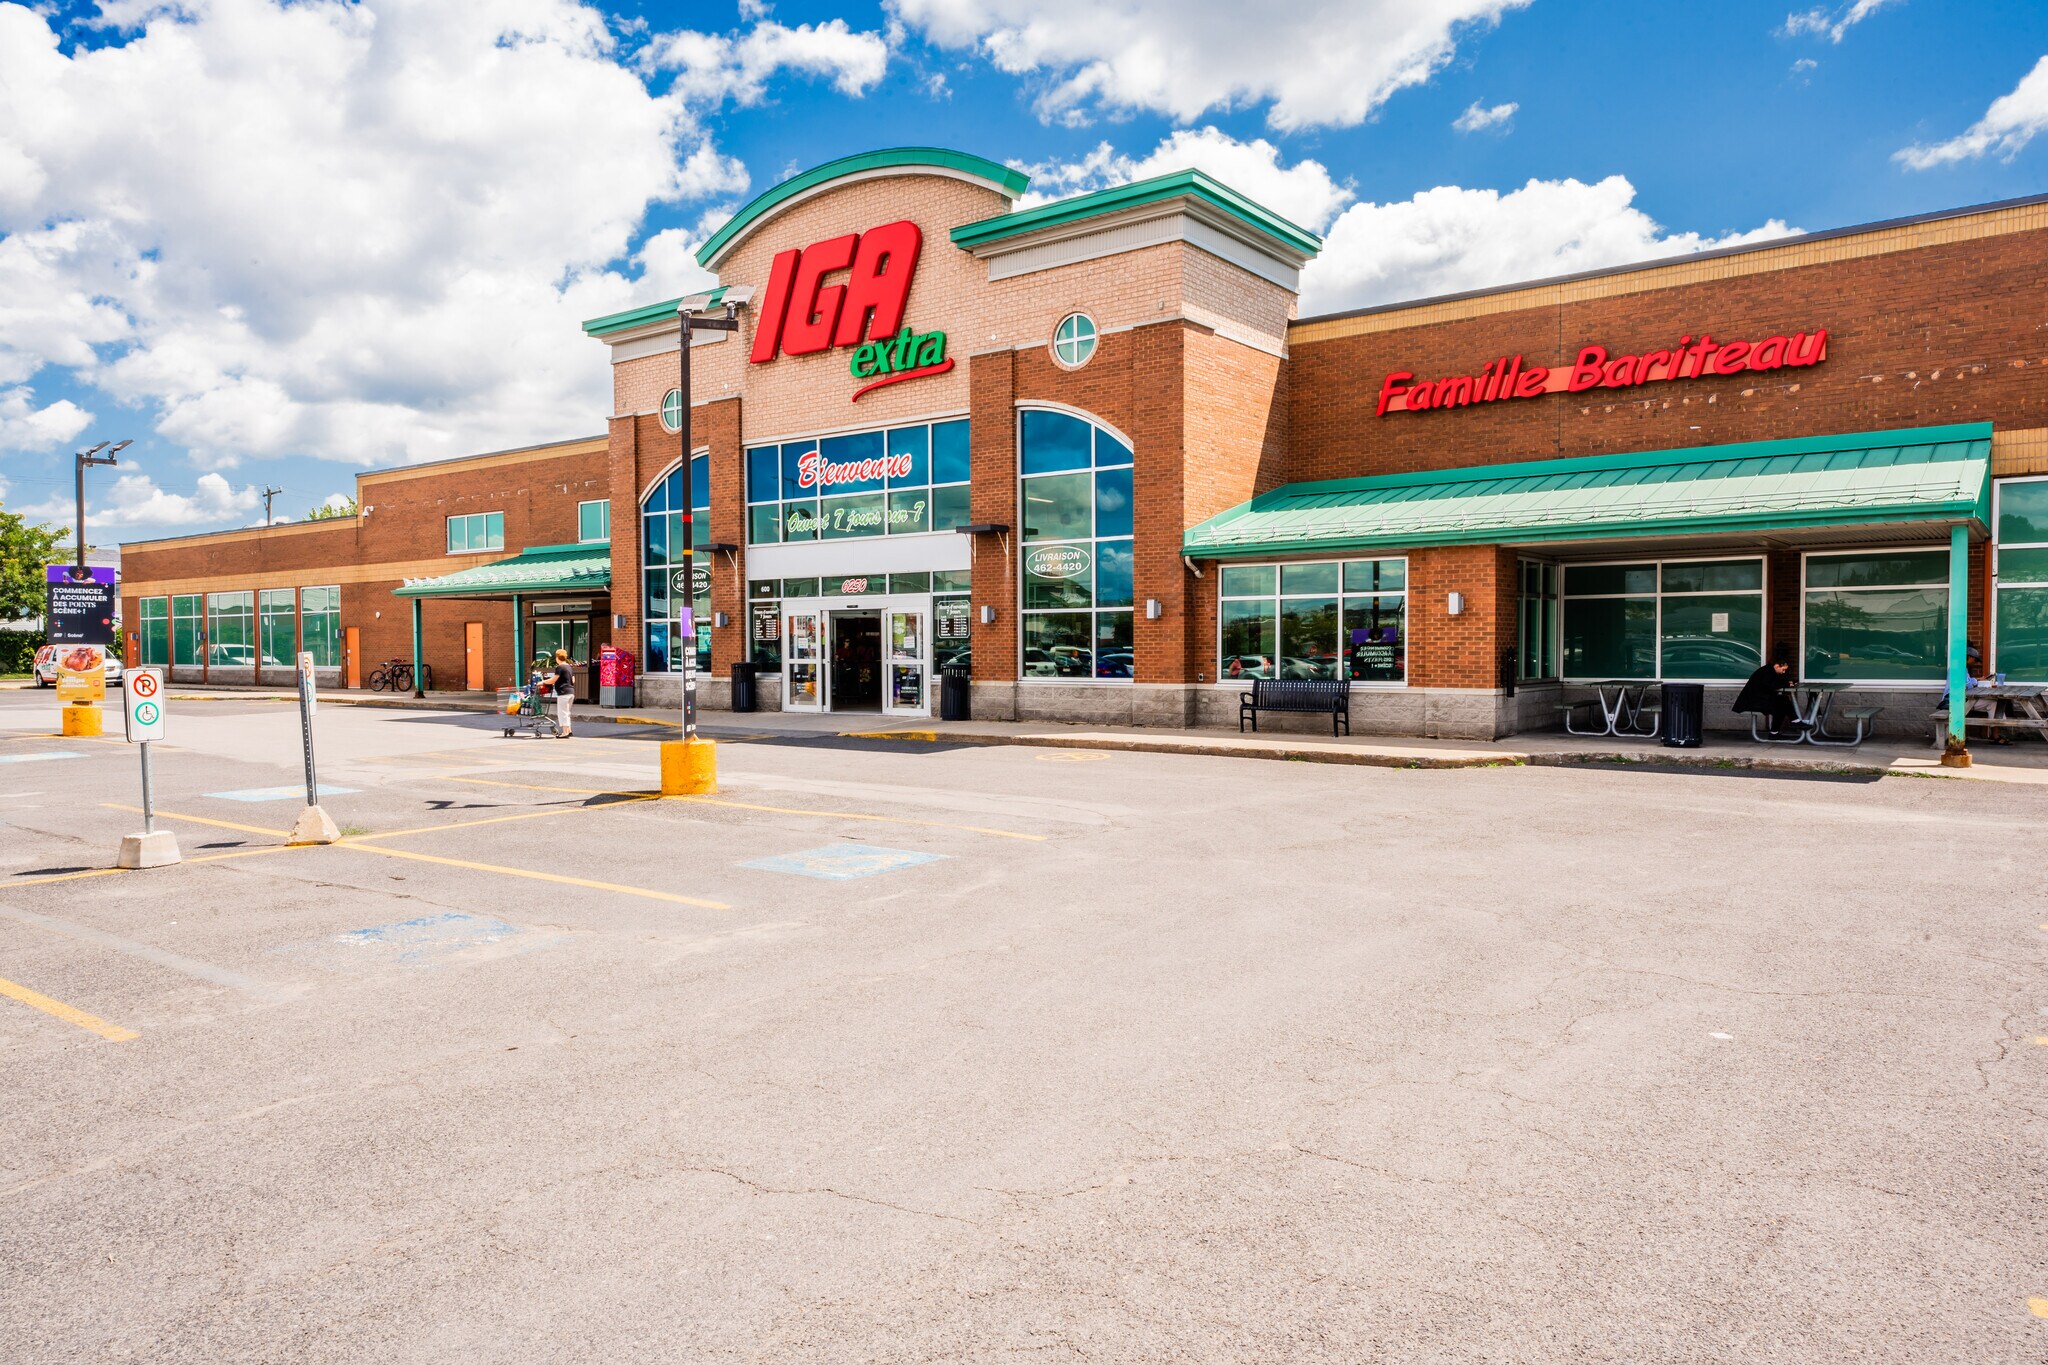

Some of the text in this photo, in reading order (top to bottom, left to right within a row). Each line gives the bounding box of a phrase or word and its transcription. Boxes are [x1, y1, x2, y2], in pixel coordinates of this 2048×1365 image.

[750, 220, 923, 364] IGA
[850, 327, 947, 378] extra
[1376, 329, 1827, 417] Famille Bariteau
[797, 450, 913, 489] Bienvenue
[787, 512, 830, 533] Ouvet
[834, 508, 845, 529] 7
[846, 510, 882, 532] jours
[913, 500, 926, 523] 7
[1034, 563, 1082, 572] 462-4420
[1035, 552, 1080, 561] LIVRAISON
[53, 592, 59, 600] À
[760, 585, 771, 593] 600
[841, 577, 868, 594] 6250
